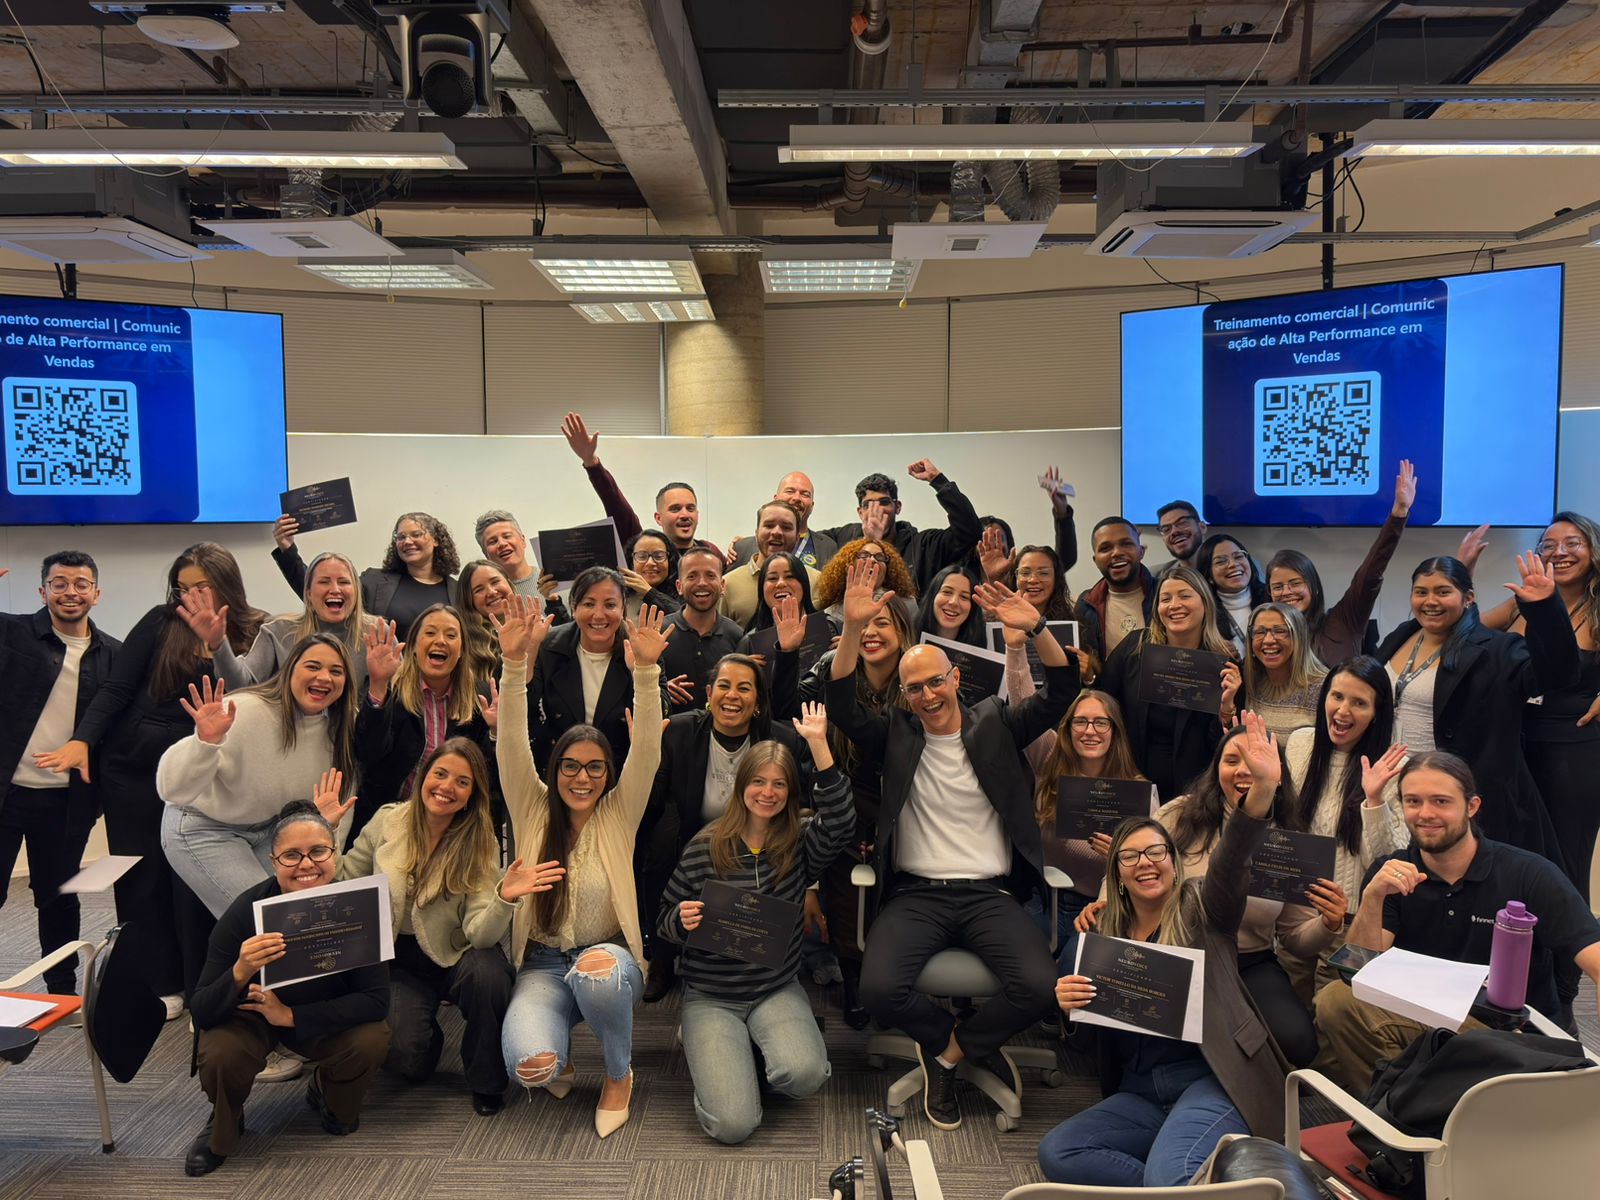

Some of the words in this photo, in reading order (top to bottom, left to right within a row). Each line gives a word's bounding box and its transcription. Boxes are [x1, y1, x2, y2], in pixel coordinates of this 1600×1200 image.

[1213, 315, 1291, 331] Treinamento
[1294, 304, 1359, 323] comercial
[1370, 297, 1435, 316] Comunic
[43, 317, 110, 330] comercial
[121, 319, 181, 335] Comunic
[5, 332, 24, 345] de
[27, 334, 56, 347] Alta
[60, 336, 148, 352] Performance
[150, 343, 172, 353] em
[1227, 336, 1257, 352] ação
[1259, 334, 1276, 347] de
[1278, 332, 1305, 345] Alta
[1309, 325, 1396, 343] Performance
[1399, 323, 1423, 334] em
[44, 355, 95, 369] Vendas
[1292, 350, 1341, 365] Vendas
